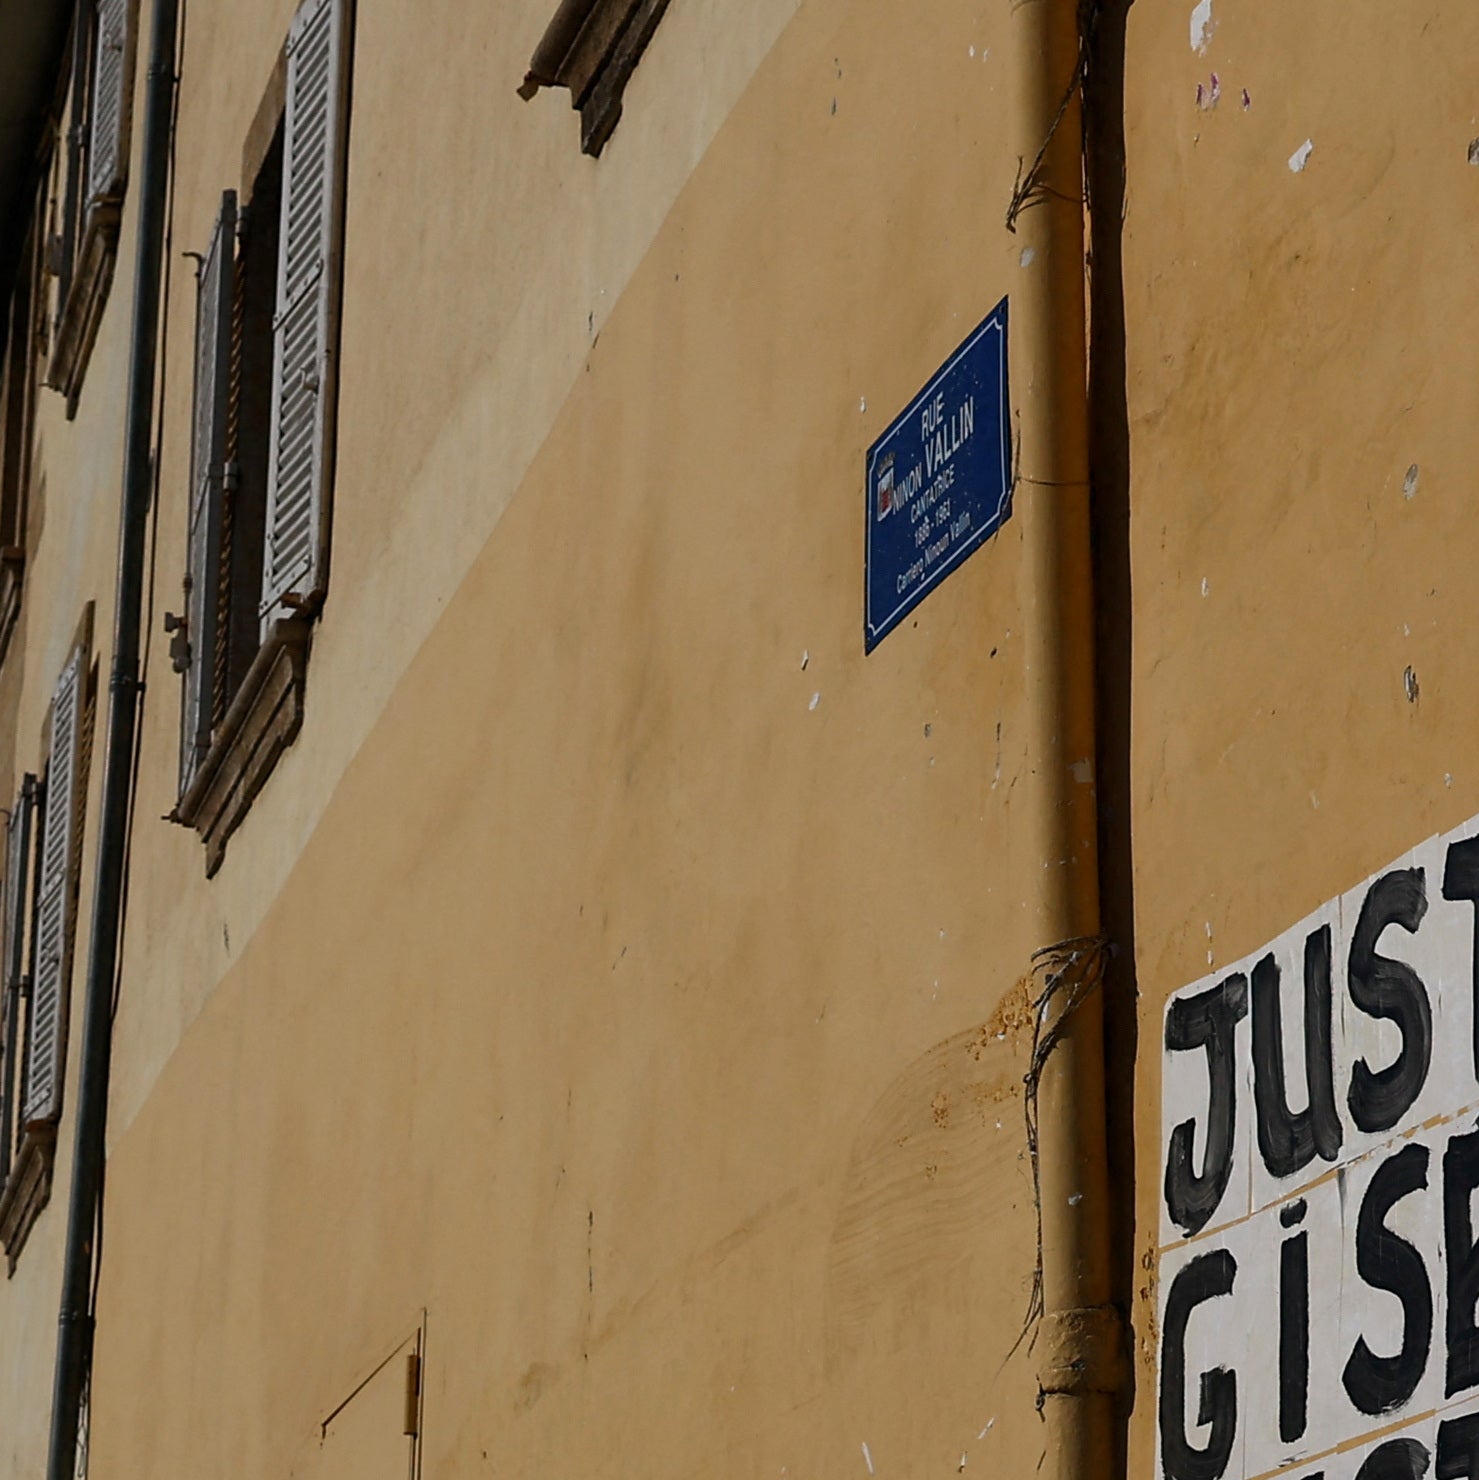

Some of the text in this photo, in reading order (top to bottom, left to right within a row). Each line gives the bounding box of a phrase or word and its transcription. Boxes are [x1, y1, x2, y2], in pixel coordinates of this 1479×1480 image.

[921, 391, 945, 442] RUE
[892, 396, 974, 515] NINON VALLIN
[911, 463, 955, 524] CANTATRICE
